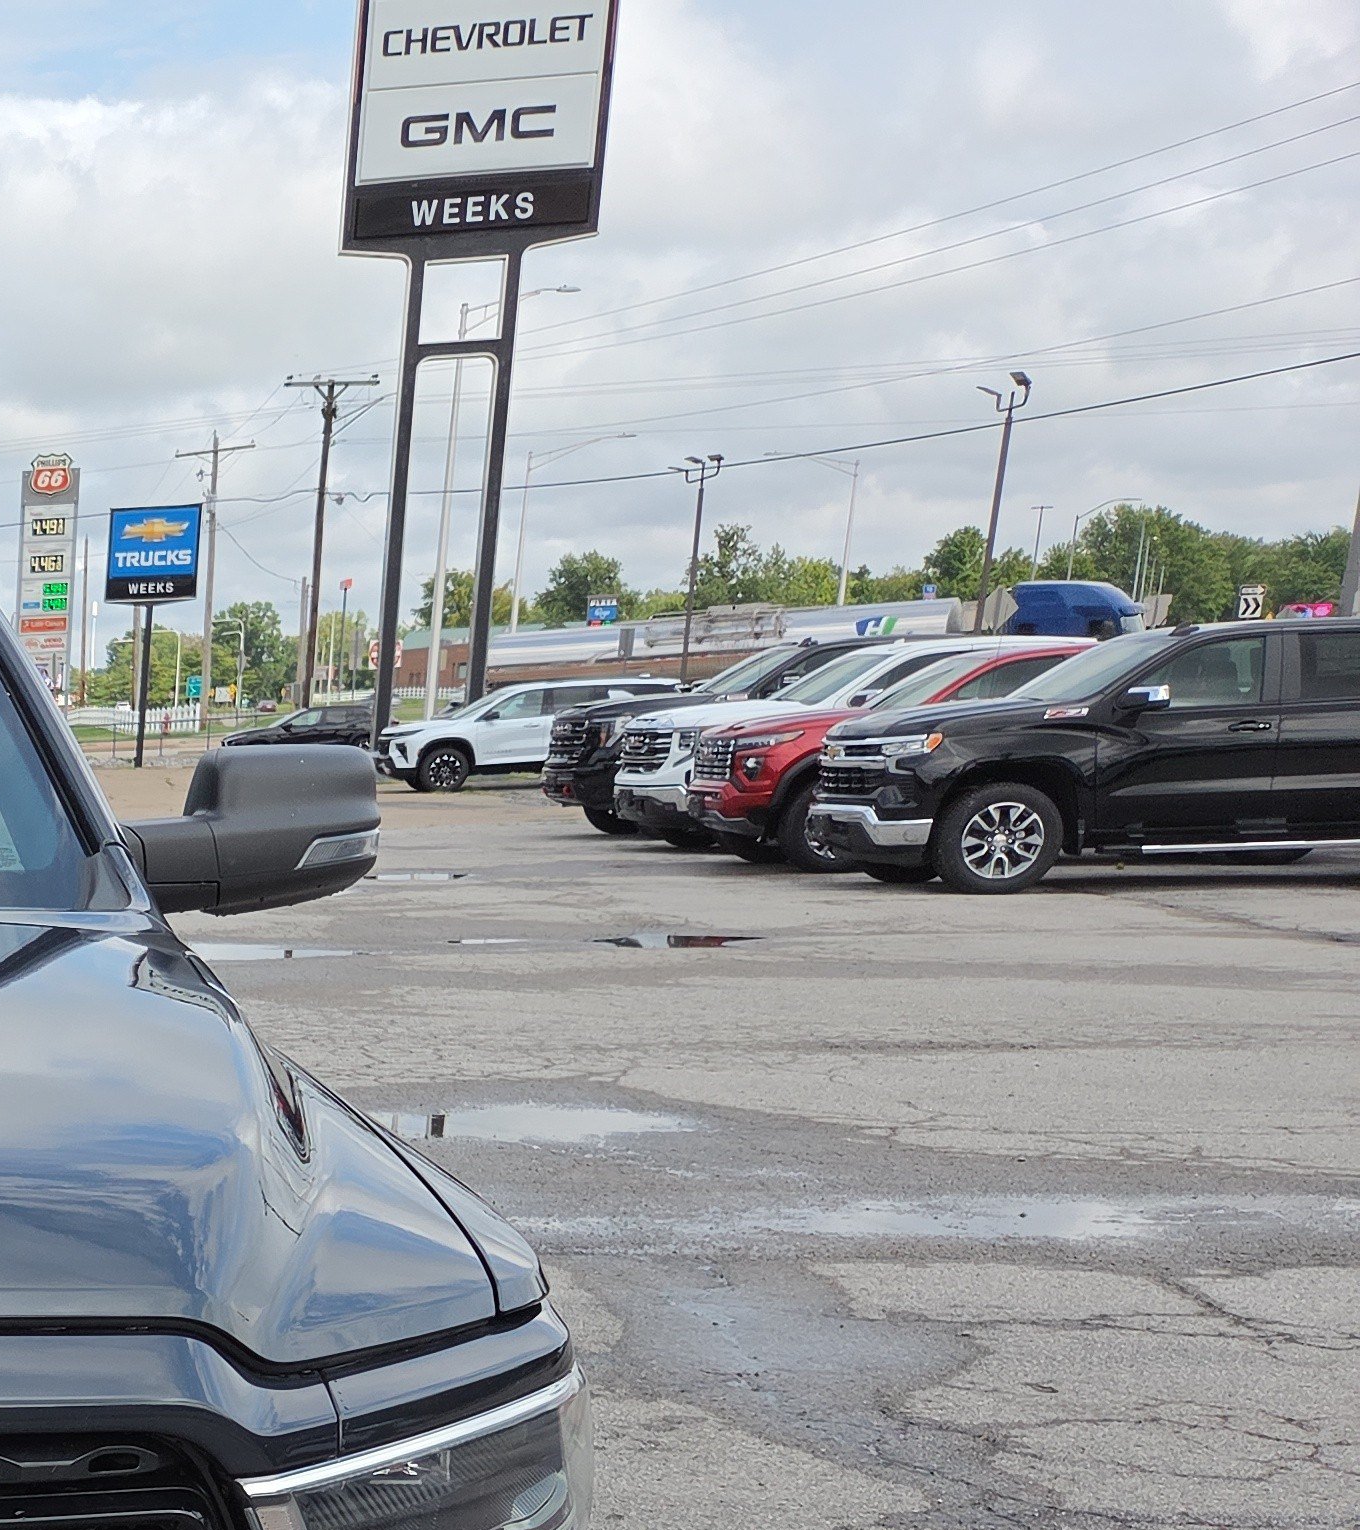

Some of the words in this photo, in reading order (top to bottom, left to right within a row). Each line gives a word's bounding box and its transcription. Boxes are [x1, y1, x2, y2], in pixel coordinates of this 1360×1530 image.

[382, 13, 594, 57] CHEVROLET
[400, 104, 557, 148] GMC
[411, 192, 534, 227] WEEKS
[37, 470, 65, 488] 66
[114, 549, 192, 568] TRUCKS
[128, 582, 174, 595] WEEKS
